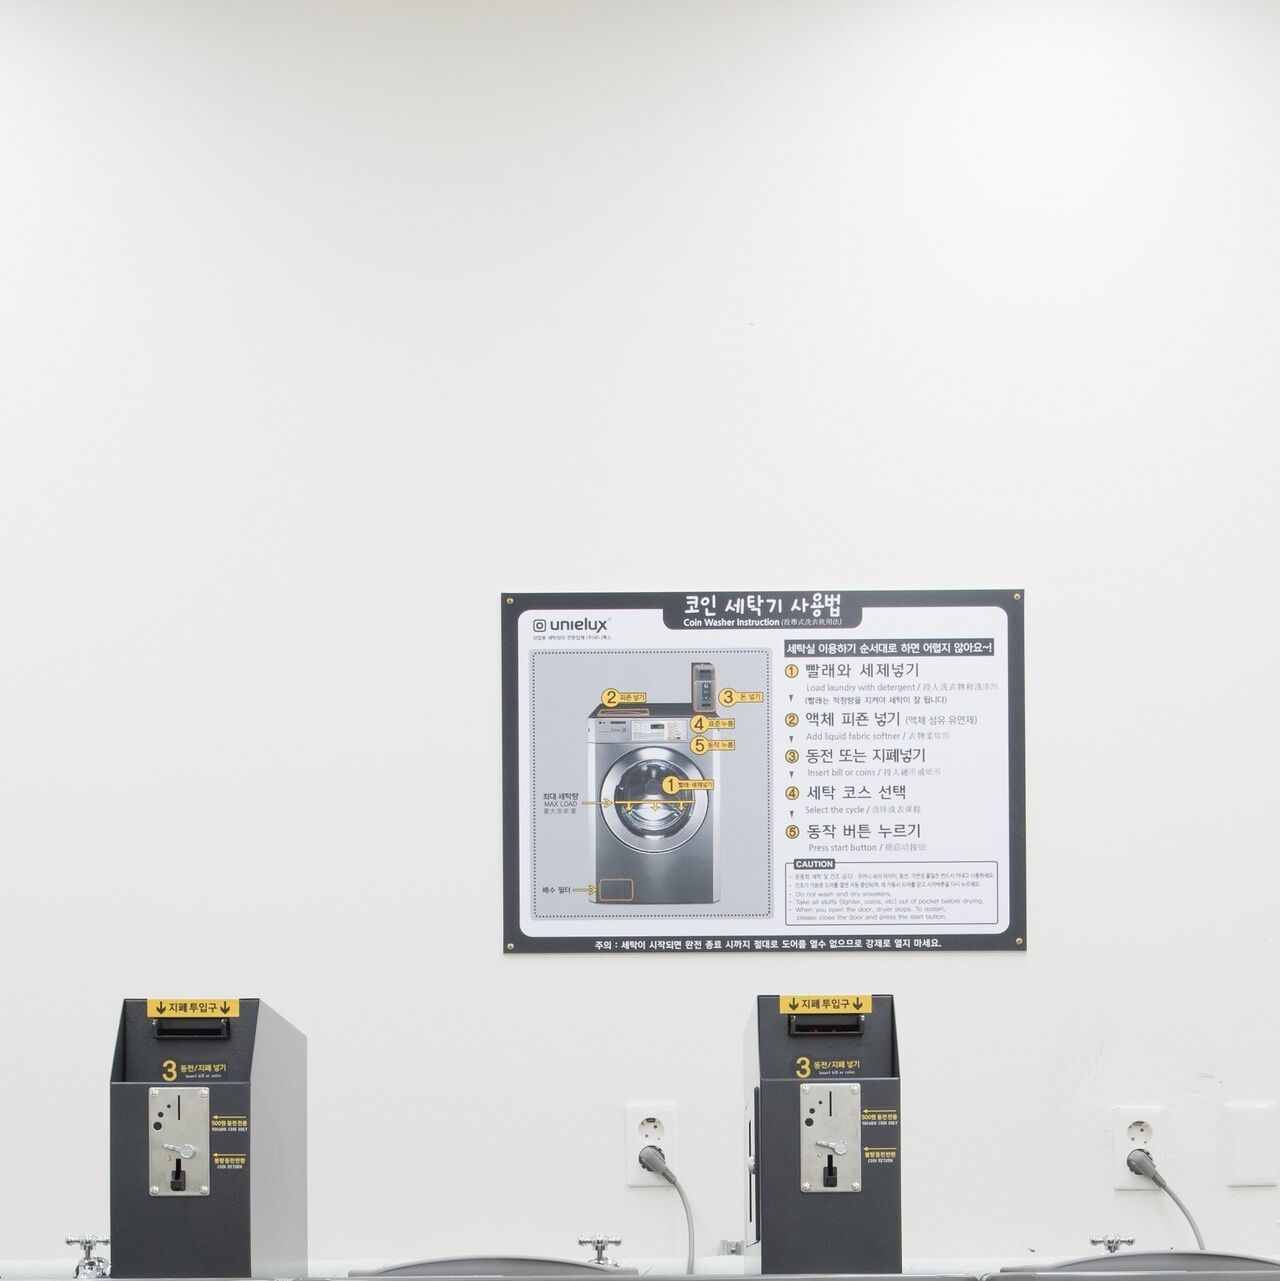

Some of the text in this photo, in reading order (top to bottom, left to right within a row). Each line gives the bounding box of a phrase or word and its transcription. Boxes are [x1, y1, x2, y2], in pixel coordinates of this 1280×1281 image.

[685, 593, 841, 617] 코인 세탁기 사용법
[550, 618, 607, 633] unielux
[683, 618, 702, 627] Coin
[704, 618, 735, 627] Washer
[736, 618, 780, 627] Instruction
[786, 644, 815, 654] 세탁실
[818, 644, 856, 654] 이용하기
[860, 643, 898, 654] 순서대로
[901, 642, 920, 654] 하면
[806, 663, 920, 678] 빨래와 세제넣기
[807, 683, 916, 694] Load laundry with detergent
[607, 690, 617, 704] 2
[724, 690, 734, 704] 3
[694, 718, 705, 730] 4
[806, 712, 900, 727] 액체 피죤 넣기
[806, 732, 900, 742] Add liquid fabric softner
[694, 738, 705, 752] 5
[806, 748, 926, 764] 동전 또는 지폐넣기
[808, 768, 830, 777] Insert
[832, 768, 843, 776] bill
[856, 768, 876, 776] coins
[807, 785, 906, 800] 세탁 코스 선택
[805, 806, 864, 816] Select the cycle
[807, 824, 920, 840] 동작 버튼 누르기
[808, 843, 877, 852] Press start button
[796, 860, 834, 868] CAUTION
[595, 938, 942, 950] 주의 세탁이 시작되면 완전 종료 시까지 절대로 도어를 열수 없으므로 강제로 열지 마세요.
[168, 1002, 218, 1013] 지폐 투입구
[802, 998, 850, 1009] 지폐 투입구
[162, 1060, 178, 1082] 3
[180, 1064, 227, 1073] 동전/지폐 넣기
[796, 1056, 812, 1078] 3
[814, 1060, 860, 1070] 동전/지폐 넣기
